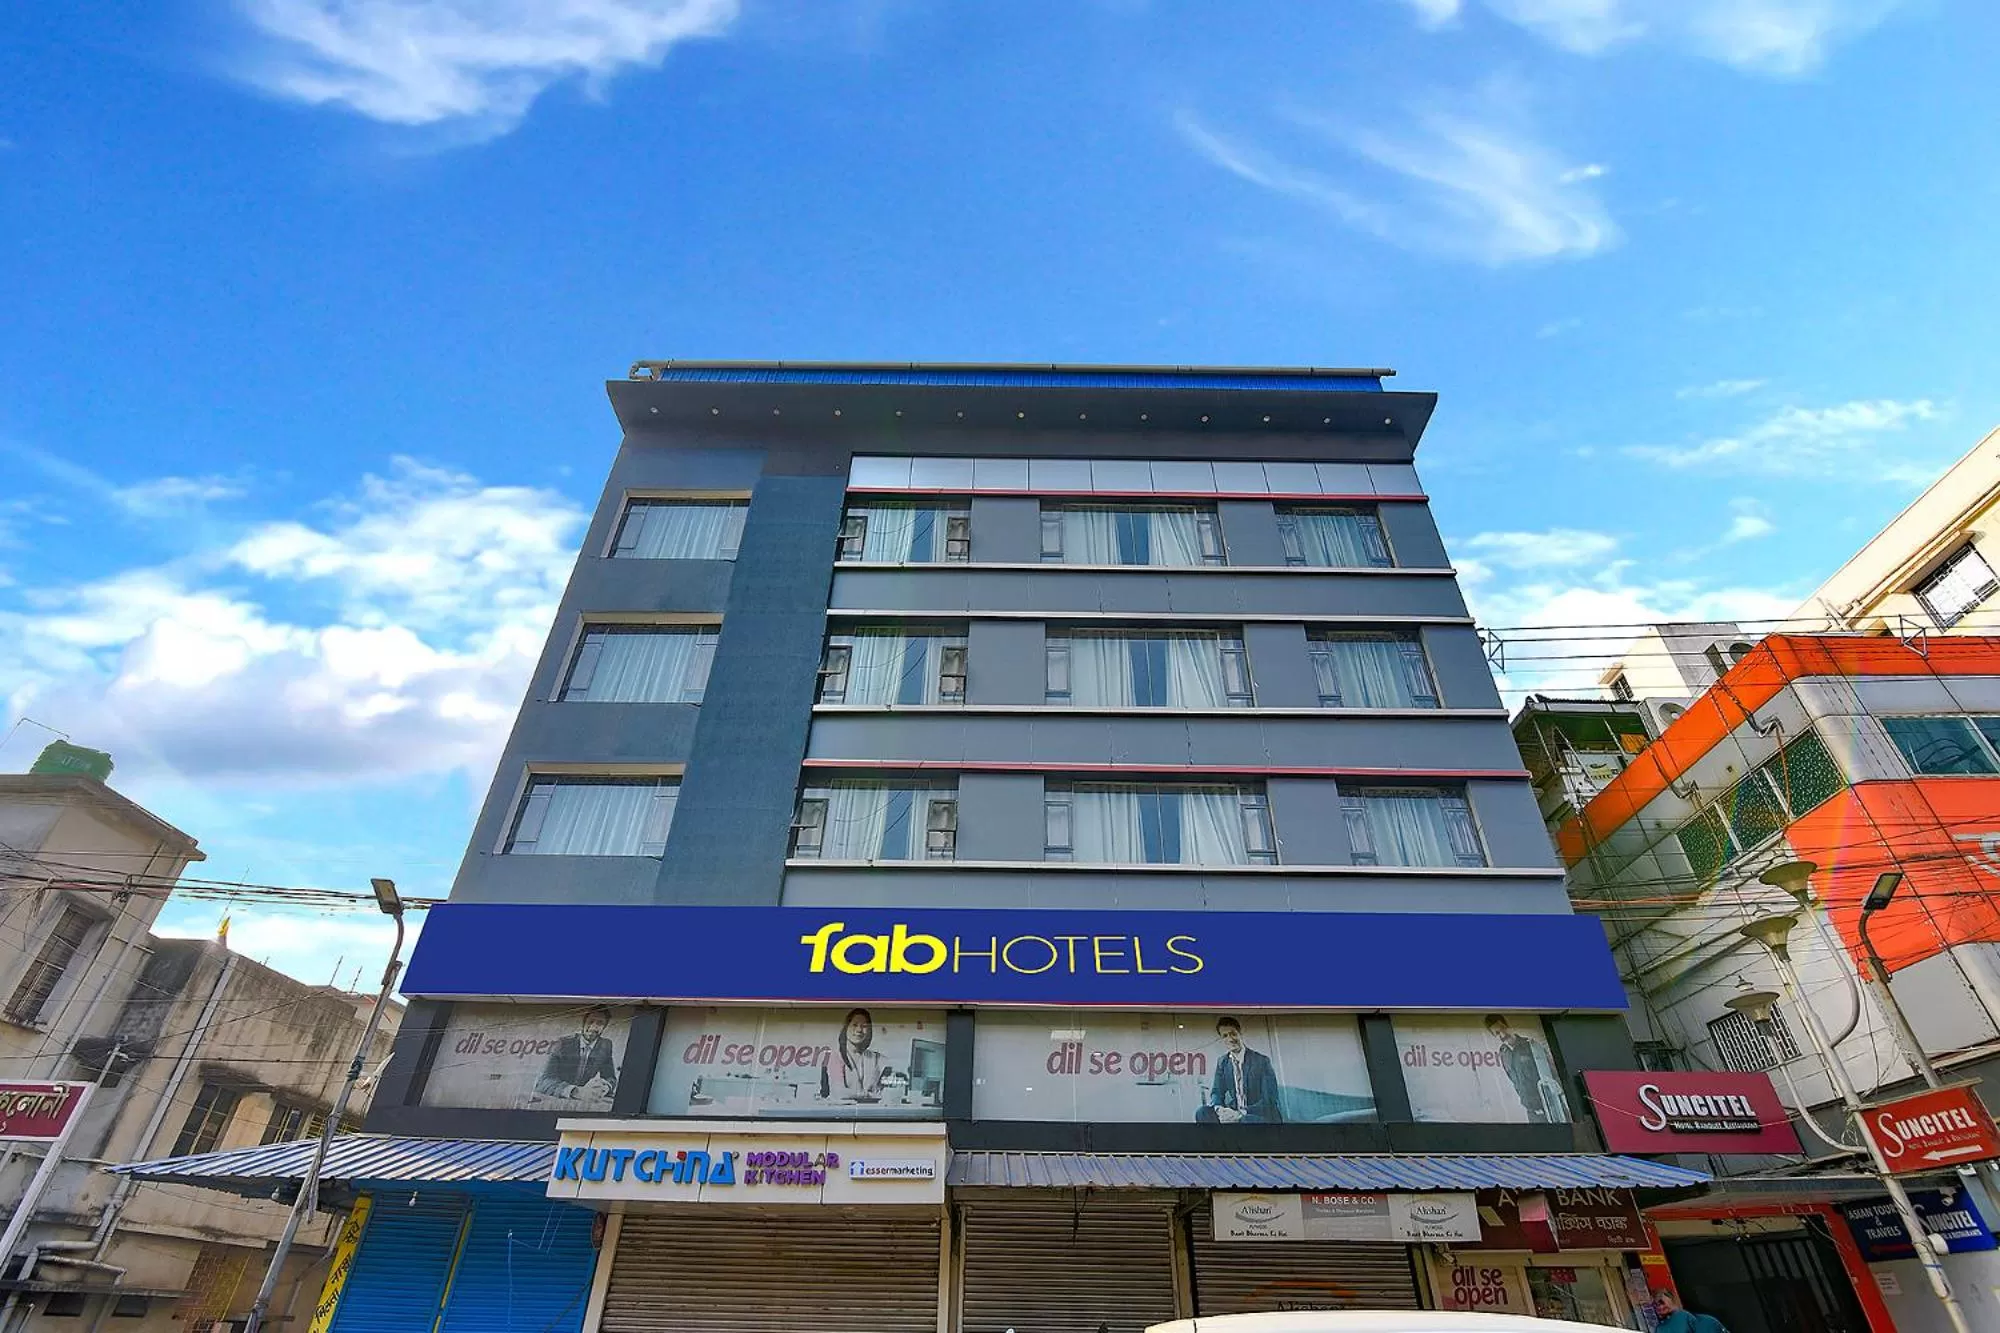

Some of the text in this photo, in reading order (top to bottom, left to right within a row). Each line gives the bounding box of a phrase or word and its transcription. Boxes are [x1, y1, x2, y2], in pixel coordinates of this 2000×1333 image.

[455, 1033, 484, 1055] dil
[482, 1040, 507, 1055] se
[683, 1035, 831, 1071] dil se open
[1046, 1042, 1206, 1082] dil se open
[1403, 1045, 1427, 1067] dil
[1431, 1051, 1454, 1067] se
[746, 1151, 840, 1169] MODULAR
[744, 1169, 827, 1186] KITCHEN
[1323, 1196, 1350, 1205] BOSE
[1351, 1196, 1359, 1205] &
[1556, 1188, 1622, 1207] BANK
[1864, 1226, 1902, 1240] TRAVELS
[1451, 1266, 1504, 1286] dil se
[1454, 1286, 1509, 1311] open
